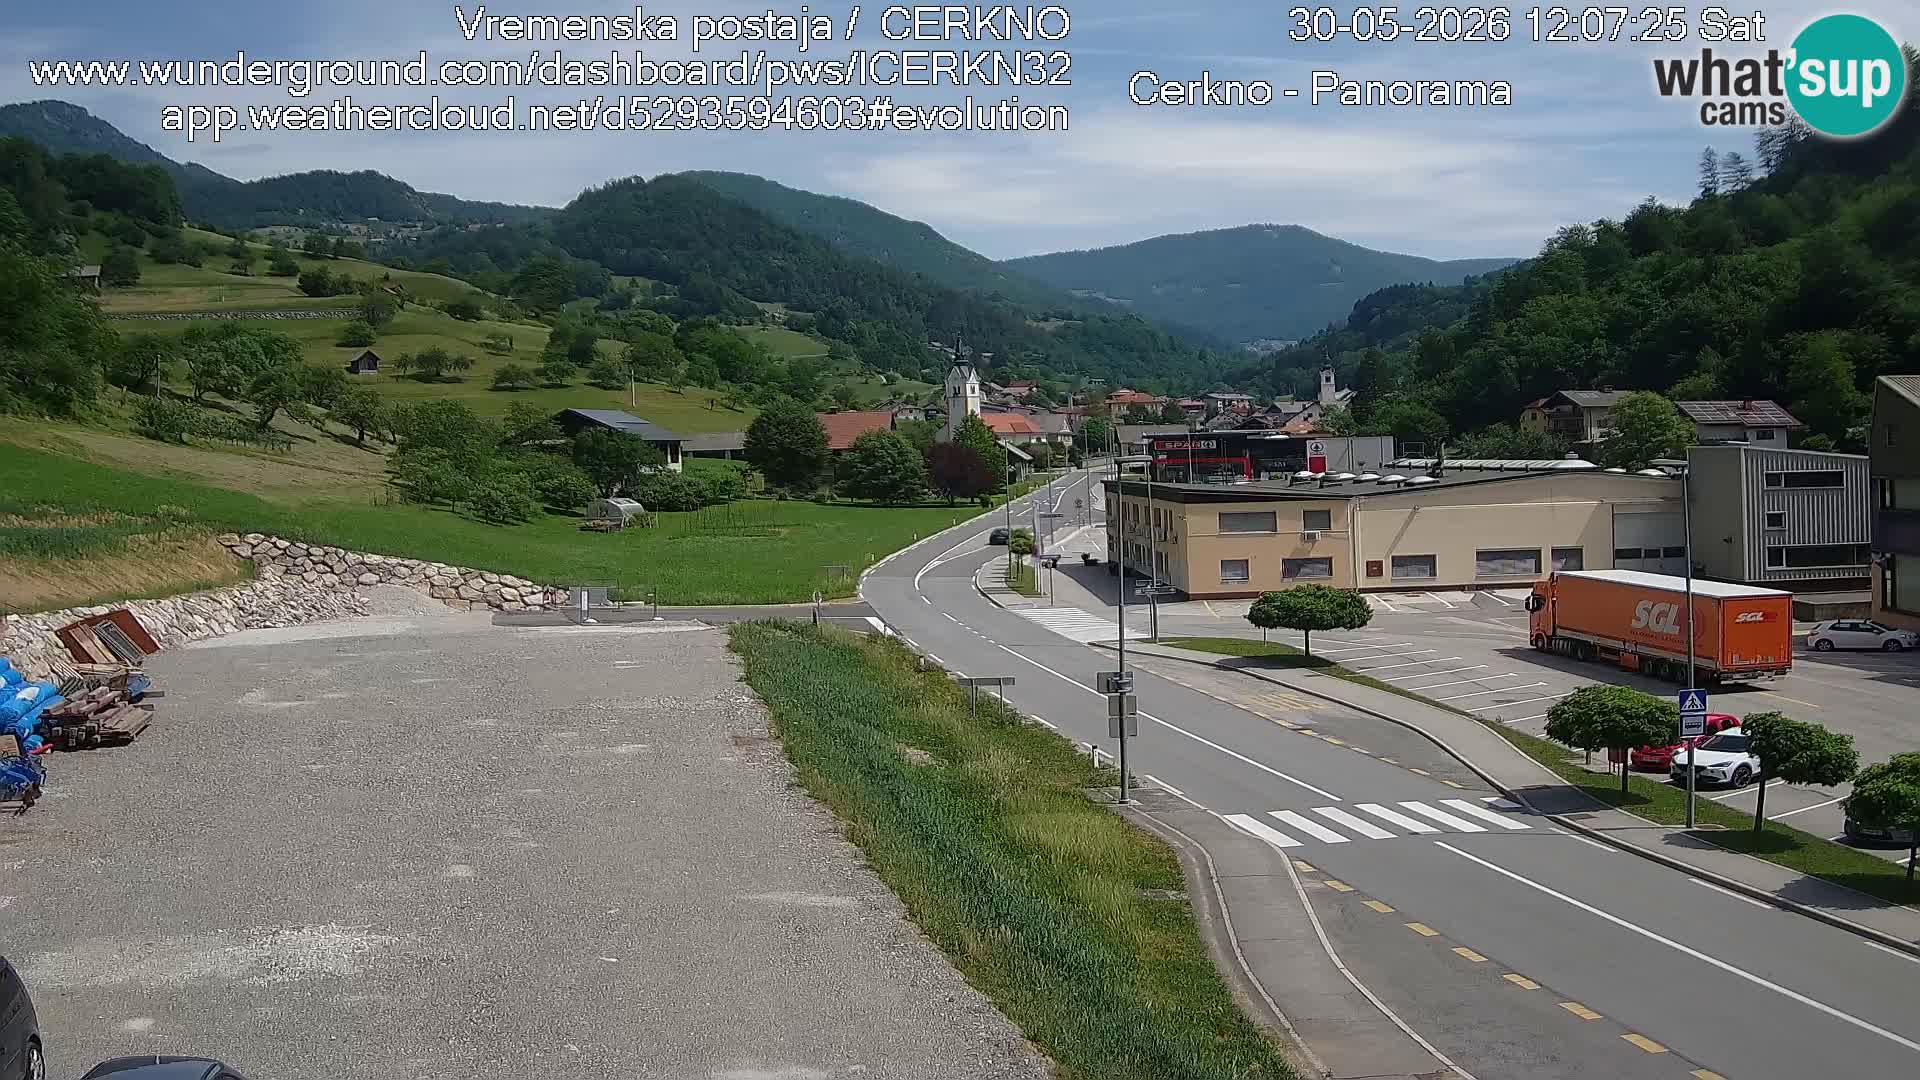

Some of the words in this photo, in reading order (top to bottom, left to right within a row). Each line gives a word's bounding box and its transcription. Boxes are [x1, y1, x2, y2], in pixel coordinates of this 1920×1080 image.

[1165, 441, 1201, 449] SPAR
[1631, 600, 1680, 634] SGL
[1735, 611, 1764, 623] SGL
